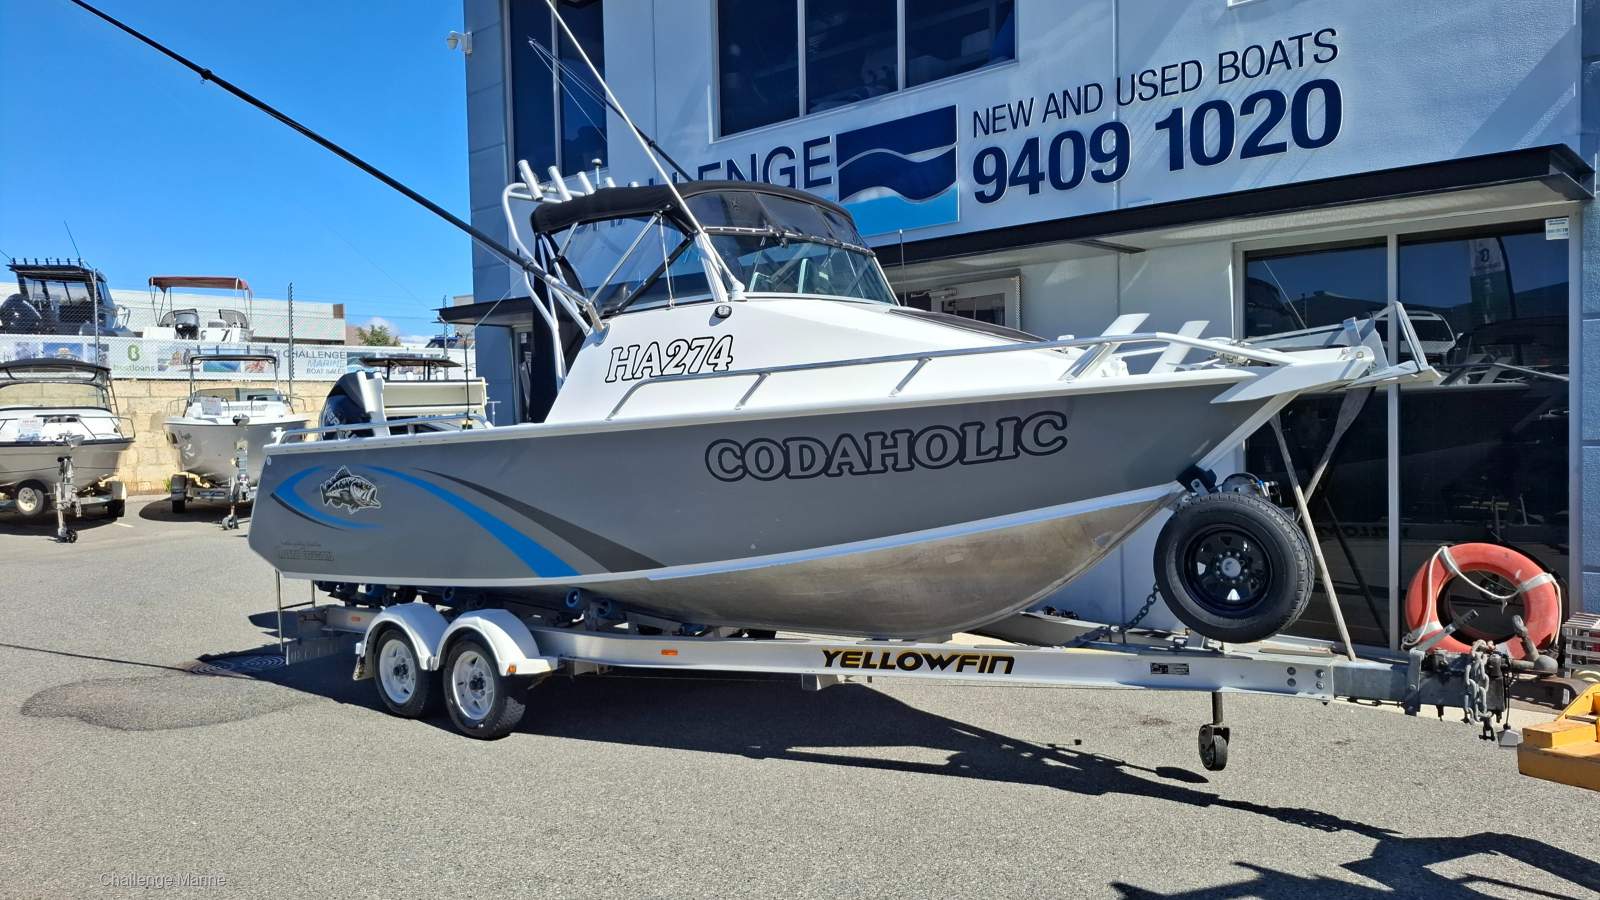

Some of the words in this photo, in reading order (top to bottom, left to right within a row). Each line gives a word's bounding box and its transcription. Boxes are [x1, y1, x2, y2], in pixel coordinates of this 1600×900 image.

[973, 97, 1035, 138] NEW
[1042, 82, 1104, 123] AND
[1116, 59, 1203, 106] USED
[1218, 28, 1339, 84] BOATS
[973, 121, 1131, 204] 9409
[1155, 78, 1343, 171] 1020
[283, 351, 346, 360] CHALLENGE
[306, 367, 323, 375] BOAT
[325, 367, 346, 375] SALES
[307, 360, 346, 368] MARINE
[605, 335, 733, 383] HA274
[705, 411, 1068, 482] CODAHOLIC
[822, 649, 1015, 675] YELLOWFIN
